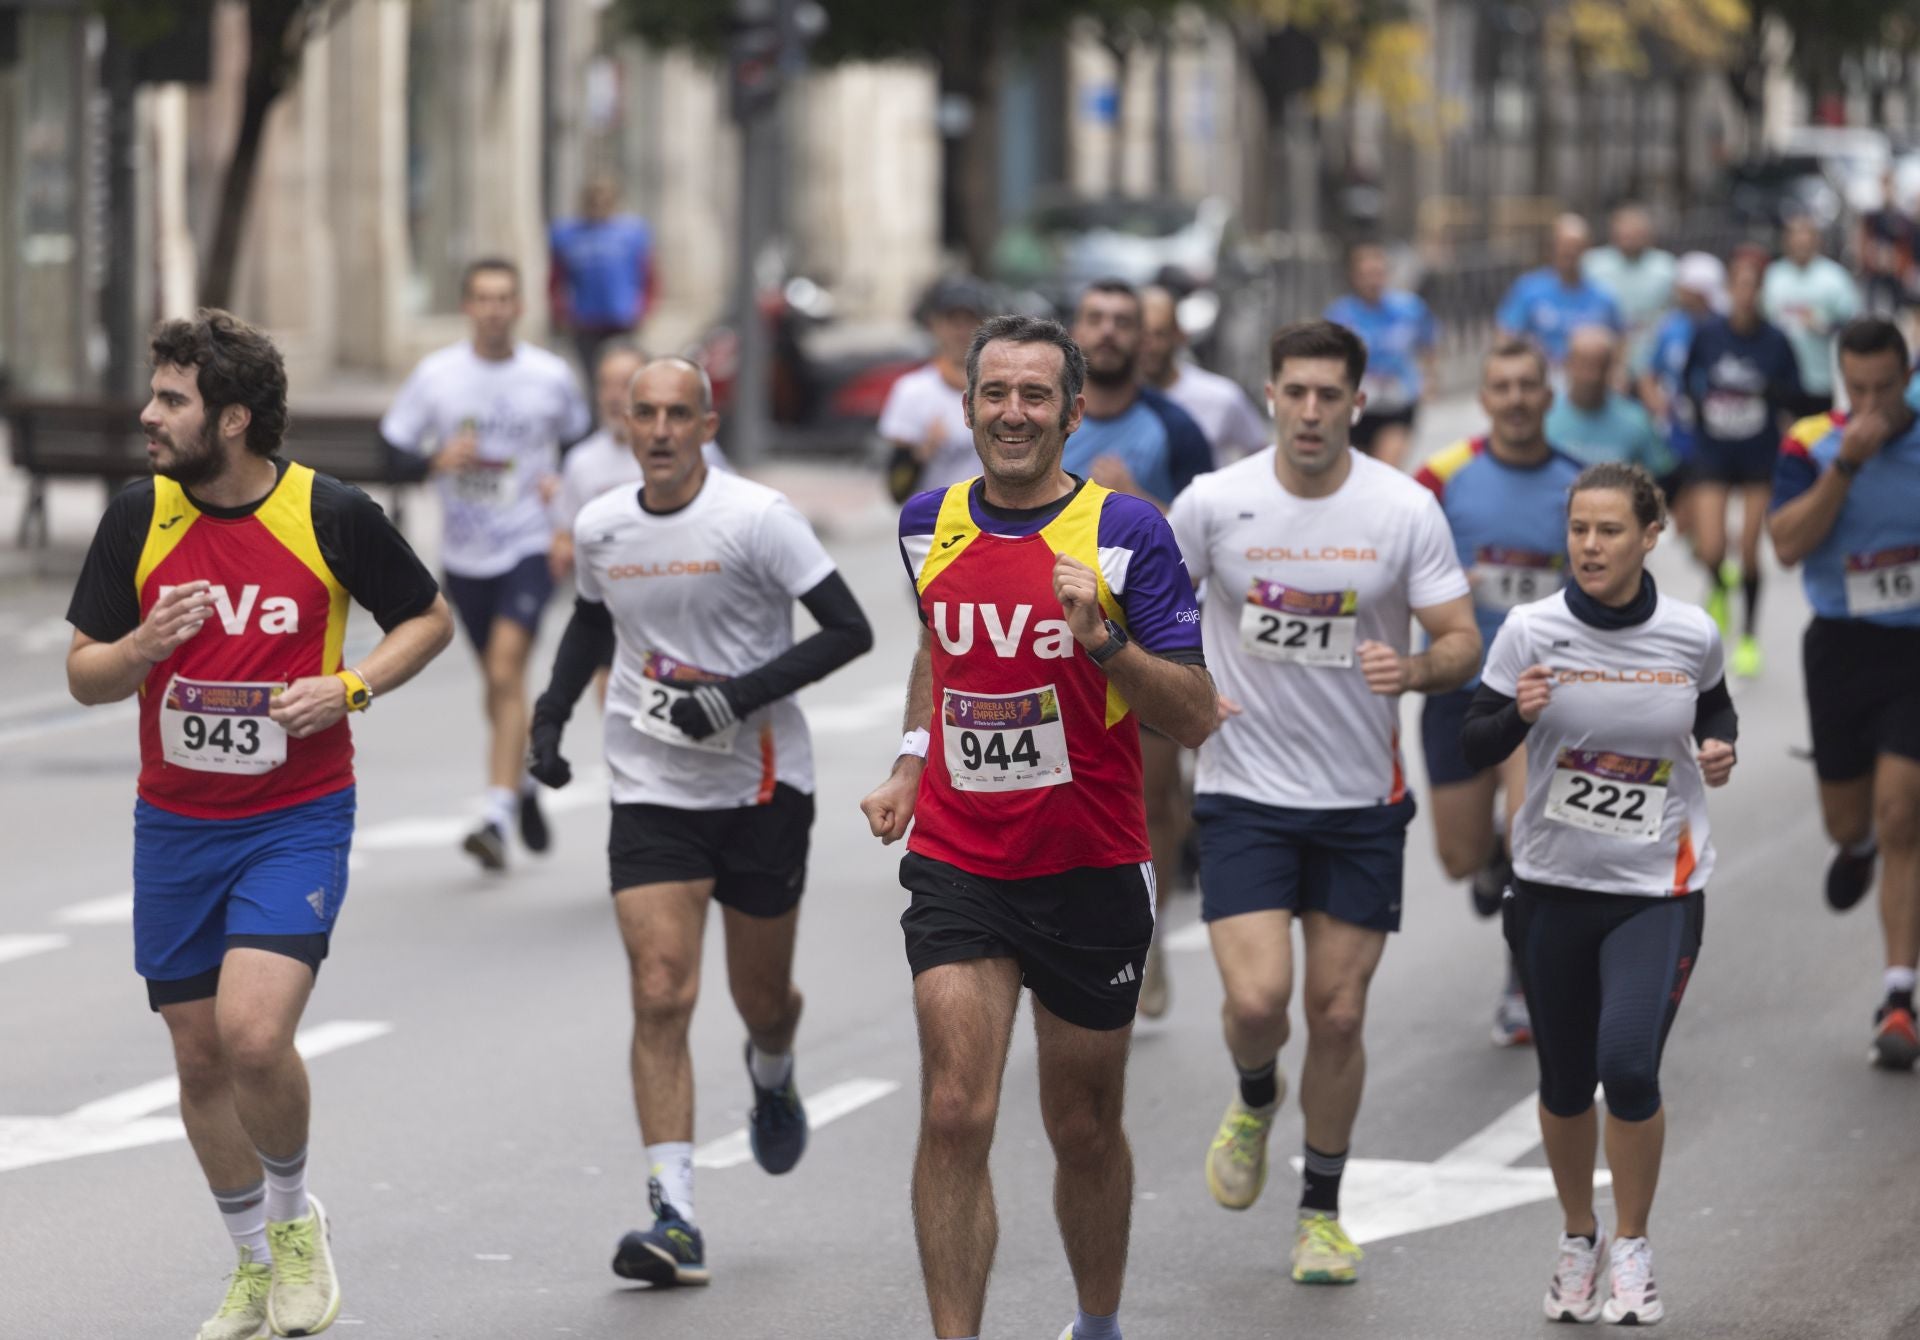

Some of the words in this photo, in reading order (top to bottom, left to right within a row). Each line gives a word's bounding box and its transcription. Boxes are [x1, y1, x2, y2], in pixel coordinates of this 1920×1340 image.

[1246, 548, 1377, 562] COLLOSA
[608, 561, 721, 580] COLLOSA
[1176, 607, 1200, 625] caja
[933, 601, 1075, 660] UVa
[1256, 614, 1332, 649] 221
[1557, 669, 1689, 685] COLLOSA
[960, 699, 972, 717] 9ª
[972, 701, 1004, 711] CARRERA
[1004, 701, 1016, 710] DE
[973, 709, 1018, 720] EMPRESAS
[183, 715, 261, 756] 943
[960, 730, 1042, 771] 944
[1565, 776, 1647, 822] 222
